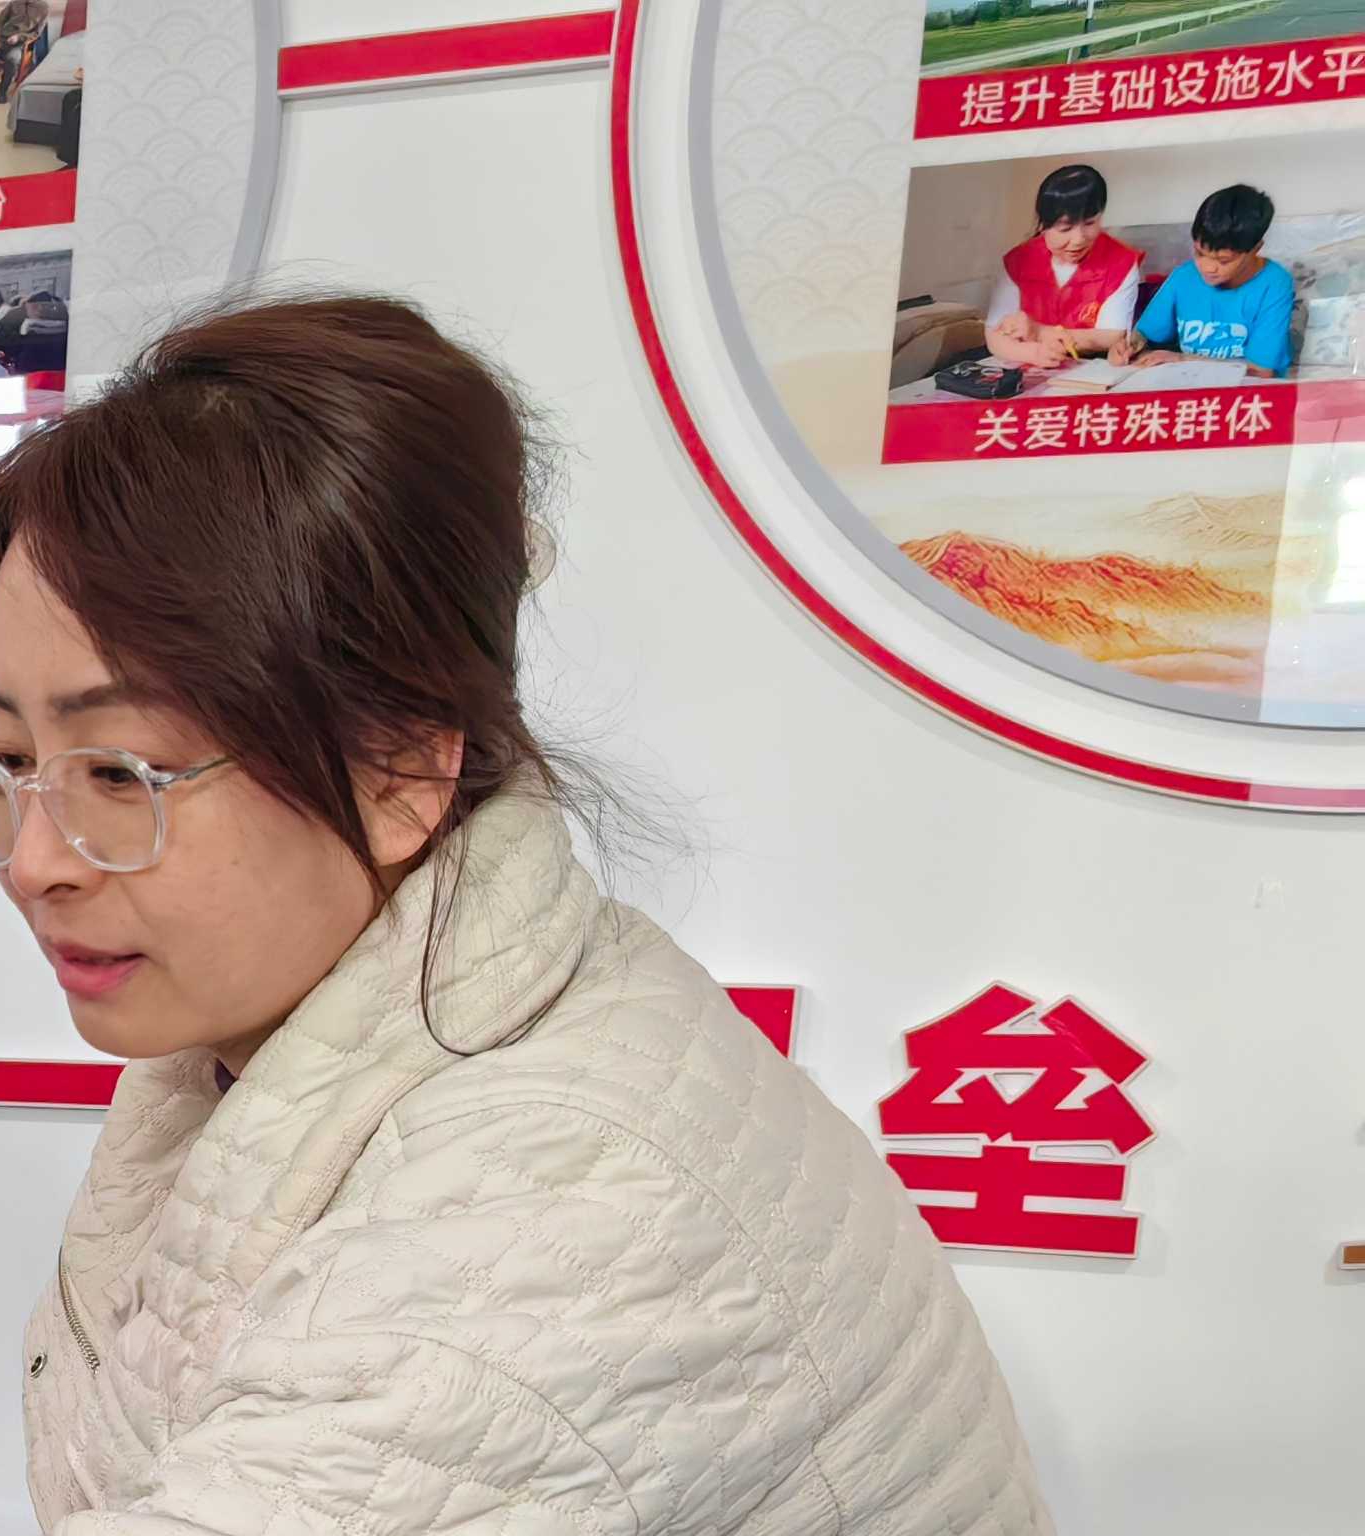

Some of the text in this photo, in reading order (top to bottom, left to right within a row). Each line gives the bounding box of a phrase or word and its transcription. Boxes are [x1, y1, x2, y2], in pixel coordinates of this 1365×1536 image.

[959, 46, 1365, 128] 提升基础设施水平
[974, 393, 1274, 454] 关爱特殊群体
